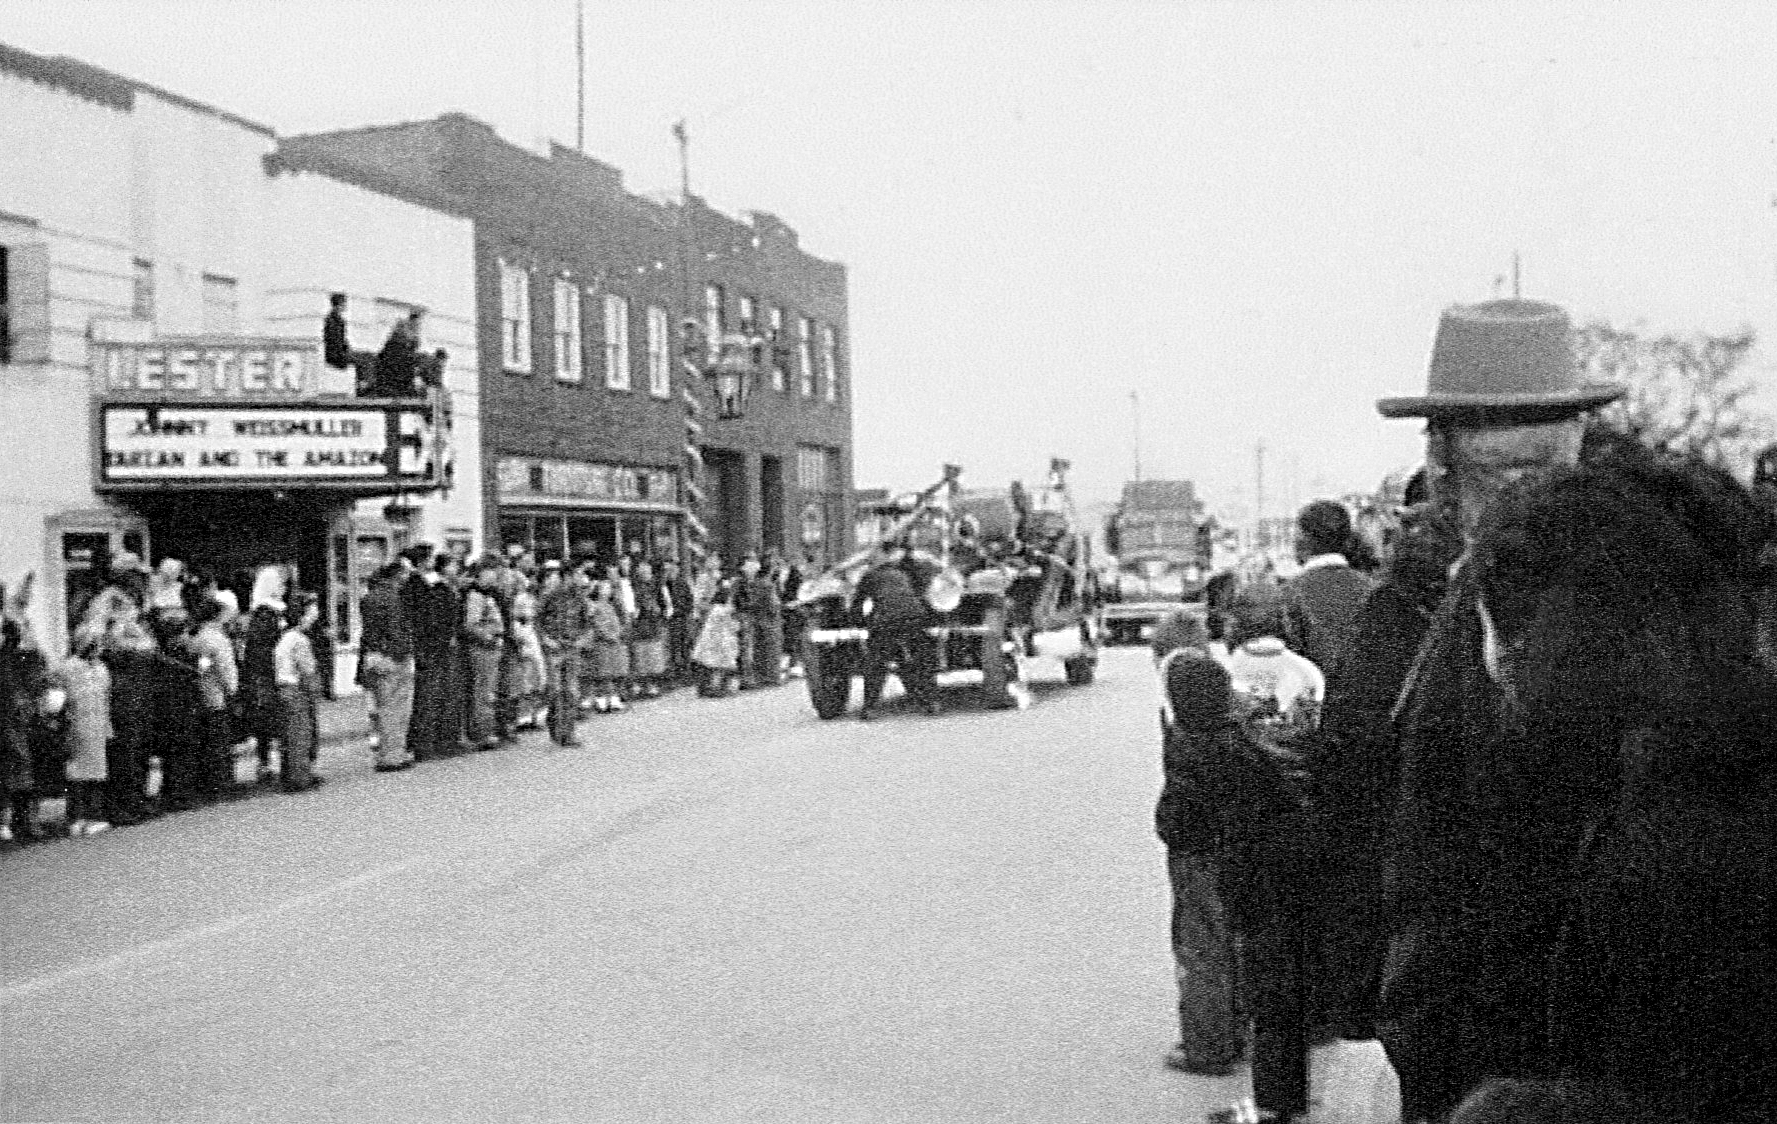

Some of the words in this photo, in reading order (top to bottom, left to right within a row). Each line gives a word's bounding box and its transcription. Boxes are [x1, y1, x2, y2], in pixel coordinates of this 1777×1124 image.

[107, 350, 303, 390] LESTER
[199, 451, 240, 467] AND
[256, 451, 289, 467] THE
